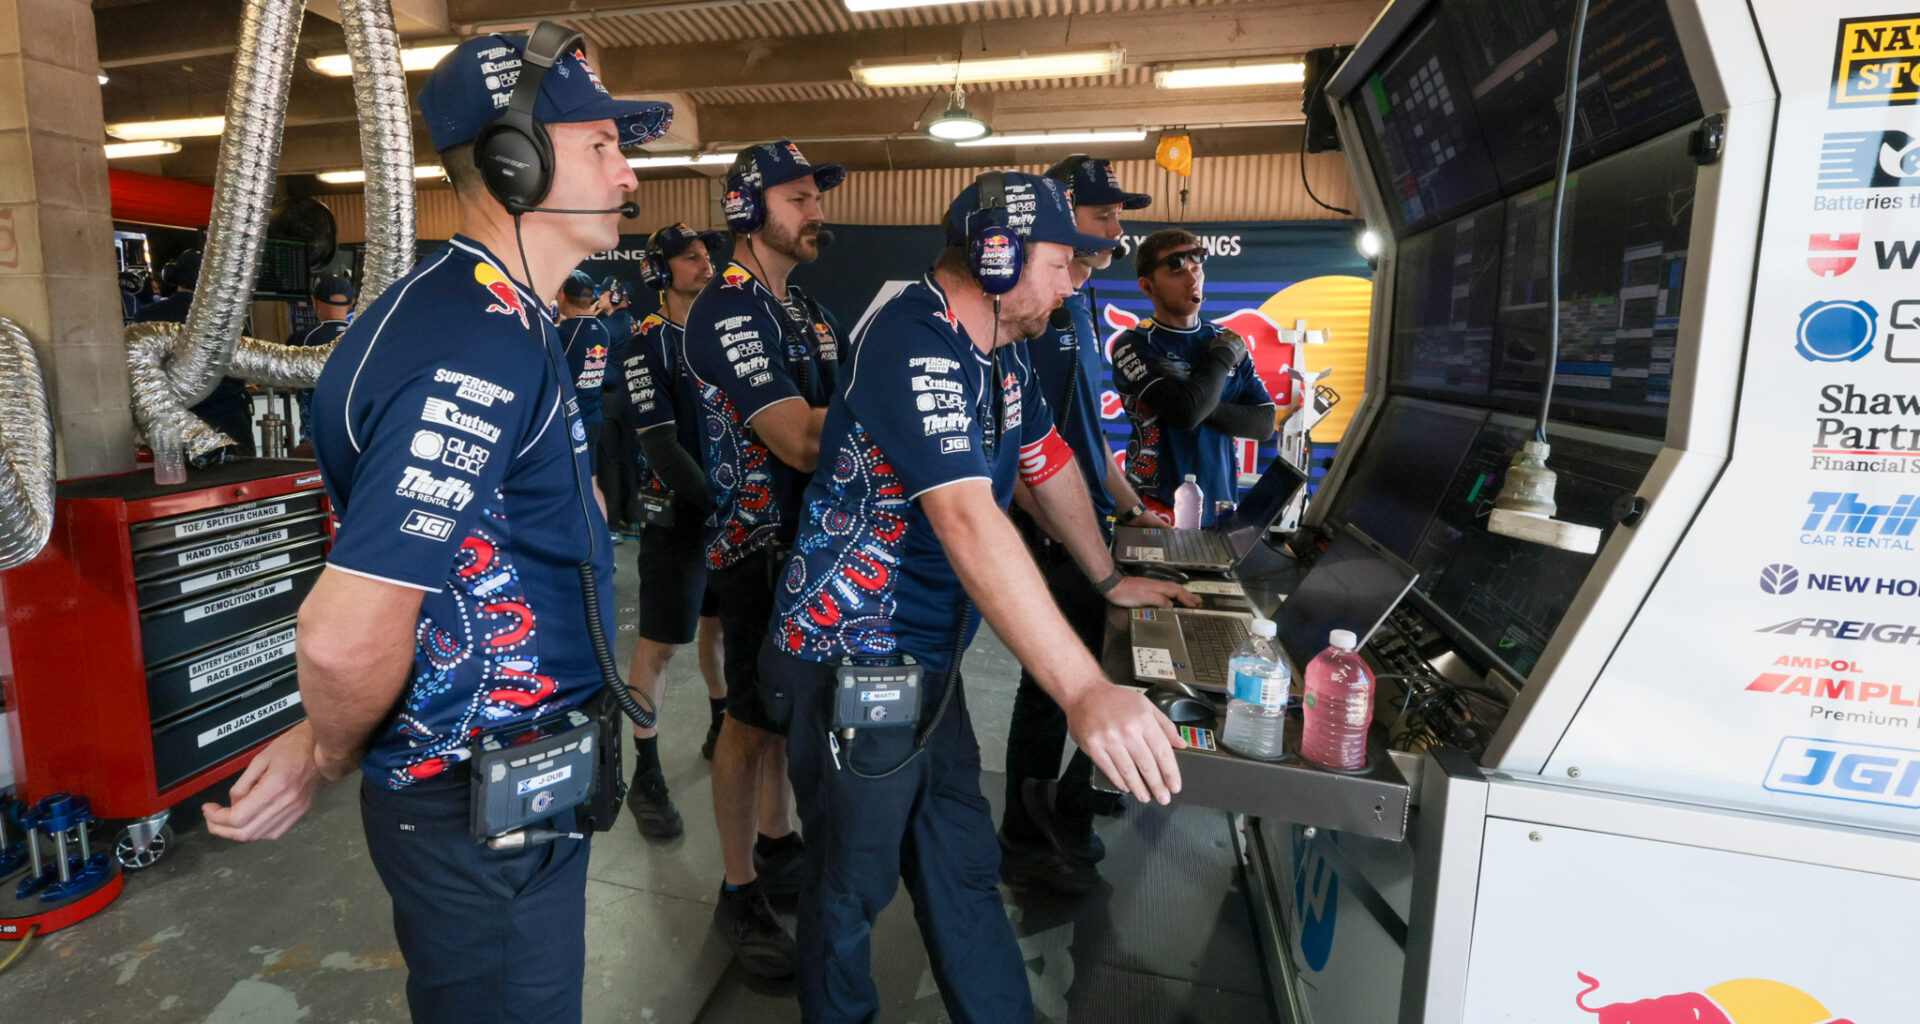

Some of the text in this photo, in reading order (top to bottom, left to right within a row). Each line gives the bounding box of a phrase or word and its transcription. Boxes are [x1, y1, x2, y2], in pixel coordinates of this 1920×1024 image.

[1852, 25, 1920, 53] NA
[499, 70, 521, 82] QUA
[1813, 194, 1903, 211] Batteries
[583, 249, 647, 261] CING
[577, 369, 605, 380] AMPO
[909, 357, 960, 371] SUPERCHEAP
[434, 368, 515, 404] SUPERCHEAP
[462, 388, 491, 404] AUTO
[430, 398, 501, 443] Century
[923, 412, 972, 433] Thrifty
[446, 437, 490, 464] QUAD
[944, 439, 968, 451] JGI
[442, 450, 485, 477] LOCK
[1810, 456, 1906, 474] Financial
[395, 488, 450, 508] CAR RENTAL
[397, 466, 475, 512] Thrifty
[206, 513, 246, 529] SPLITTER
[247, 506, 279, 520] CHANGE
[405, 515, 452, 538] JGI
[185, 548, 211, 561] HAND
[213, 531, 283, 554] TOOLS/HAMMERS
[1800, 534, 1914, 551] CAR RENTAL
[216, 570, 232, 582] AIR
[234, 561, 261, 577] TOOLS
[1807, 573, 1920, 597] NEW HO
[204, 591, 256, 615] DEMOLITION
[258, 585, 276, 598] SAW
[191, 657, 222, 675] BATTERY
[223, 646, 250, 664] CHANGE
[255, 639, 269, 652] RAD
[269, 630, 294, 647] BLOWER
[1772, 655, 1863, 673] AMPOL
[206, 647, 284, 684] RACE REPAIR TAPE
[1779, 676, 1920, 707] AMPL
[216, 698, 288, 737] AIR JACK SKATES
[1810, 705, 1908, 728] Premium
[538, 772, 564, 785] J-DUB
[1780, 748, 1920, 797] JGI
